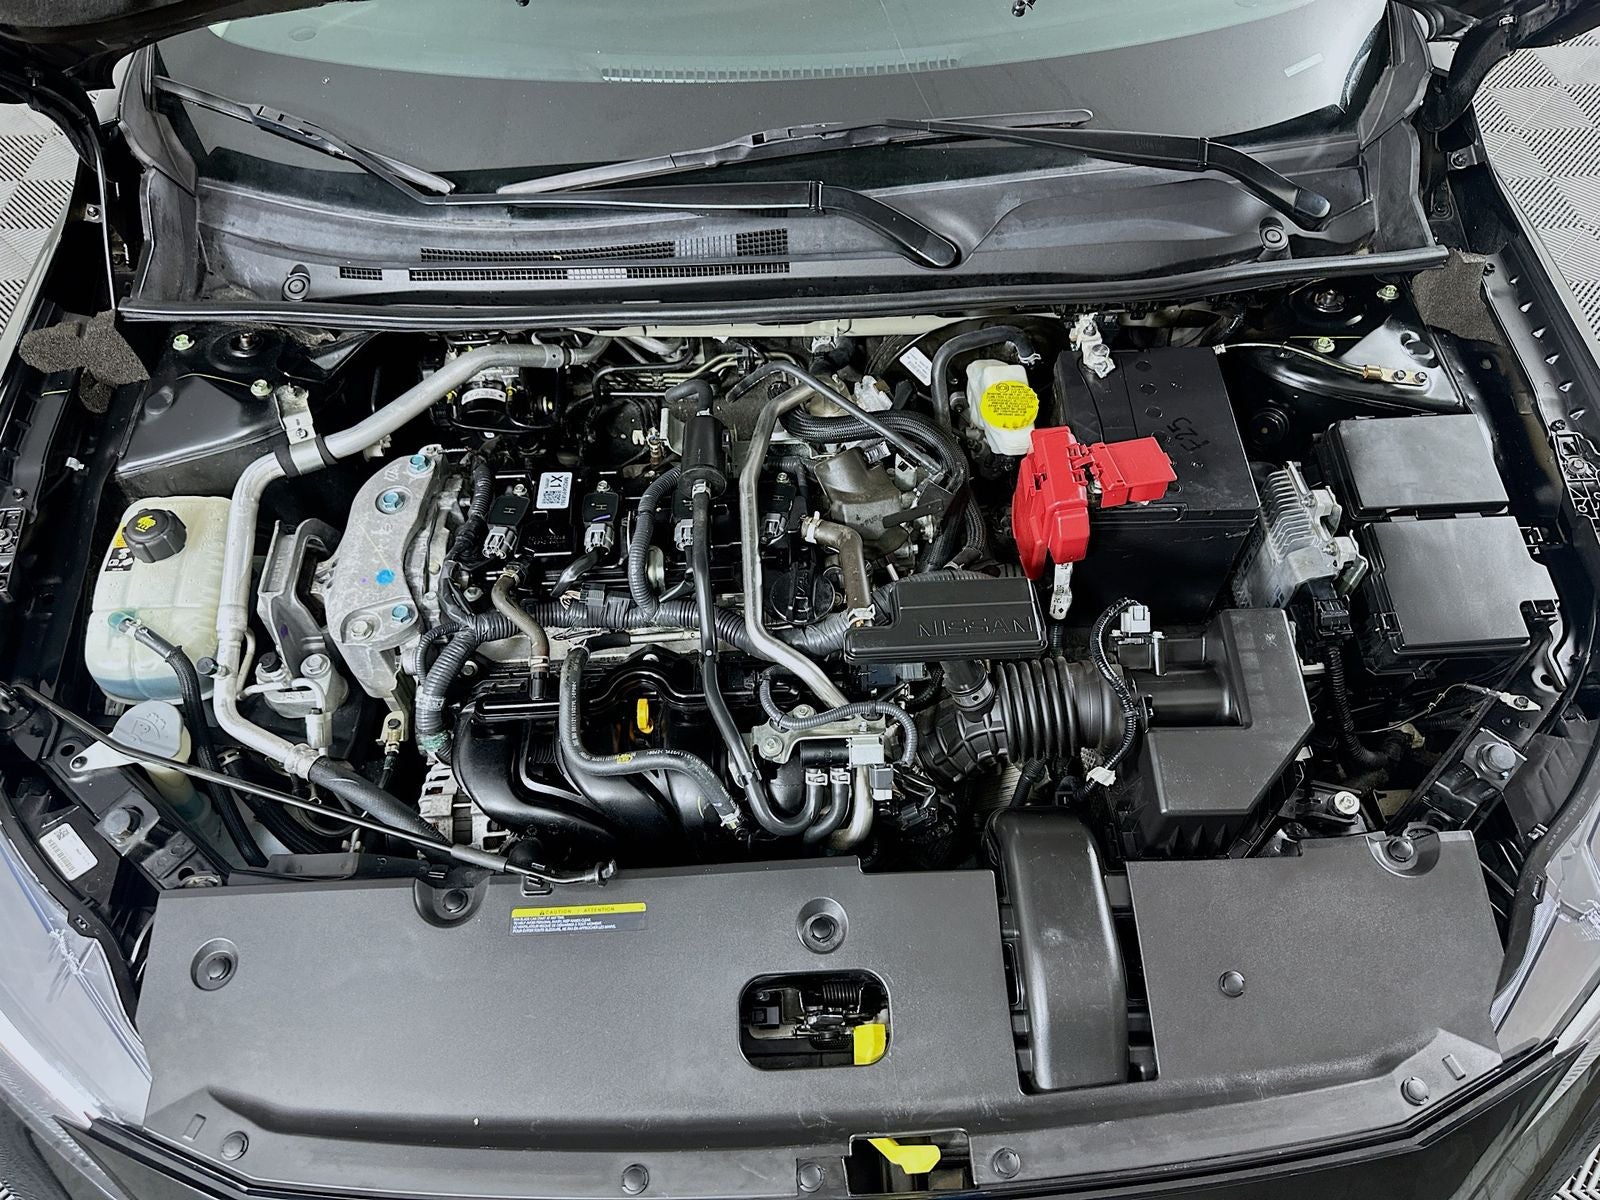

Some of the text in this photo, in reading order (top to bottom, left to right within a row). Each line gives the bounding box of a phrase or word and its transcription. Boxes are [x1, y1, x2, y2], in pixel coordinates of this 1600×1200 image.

[1166, 417, 1210, 452] F25
[550, 475, 563, 488] X1
[919, 616, 1033, 637] NISSAN
